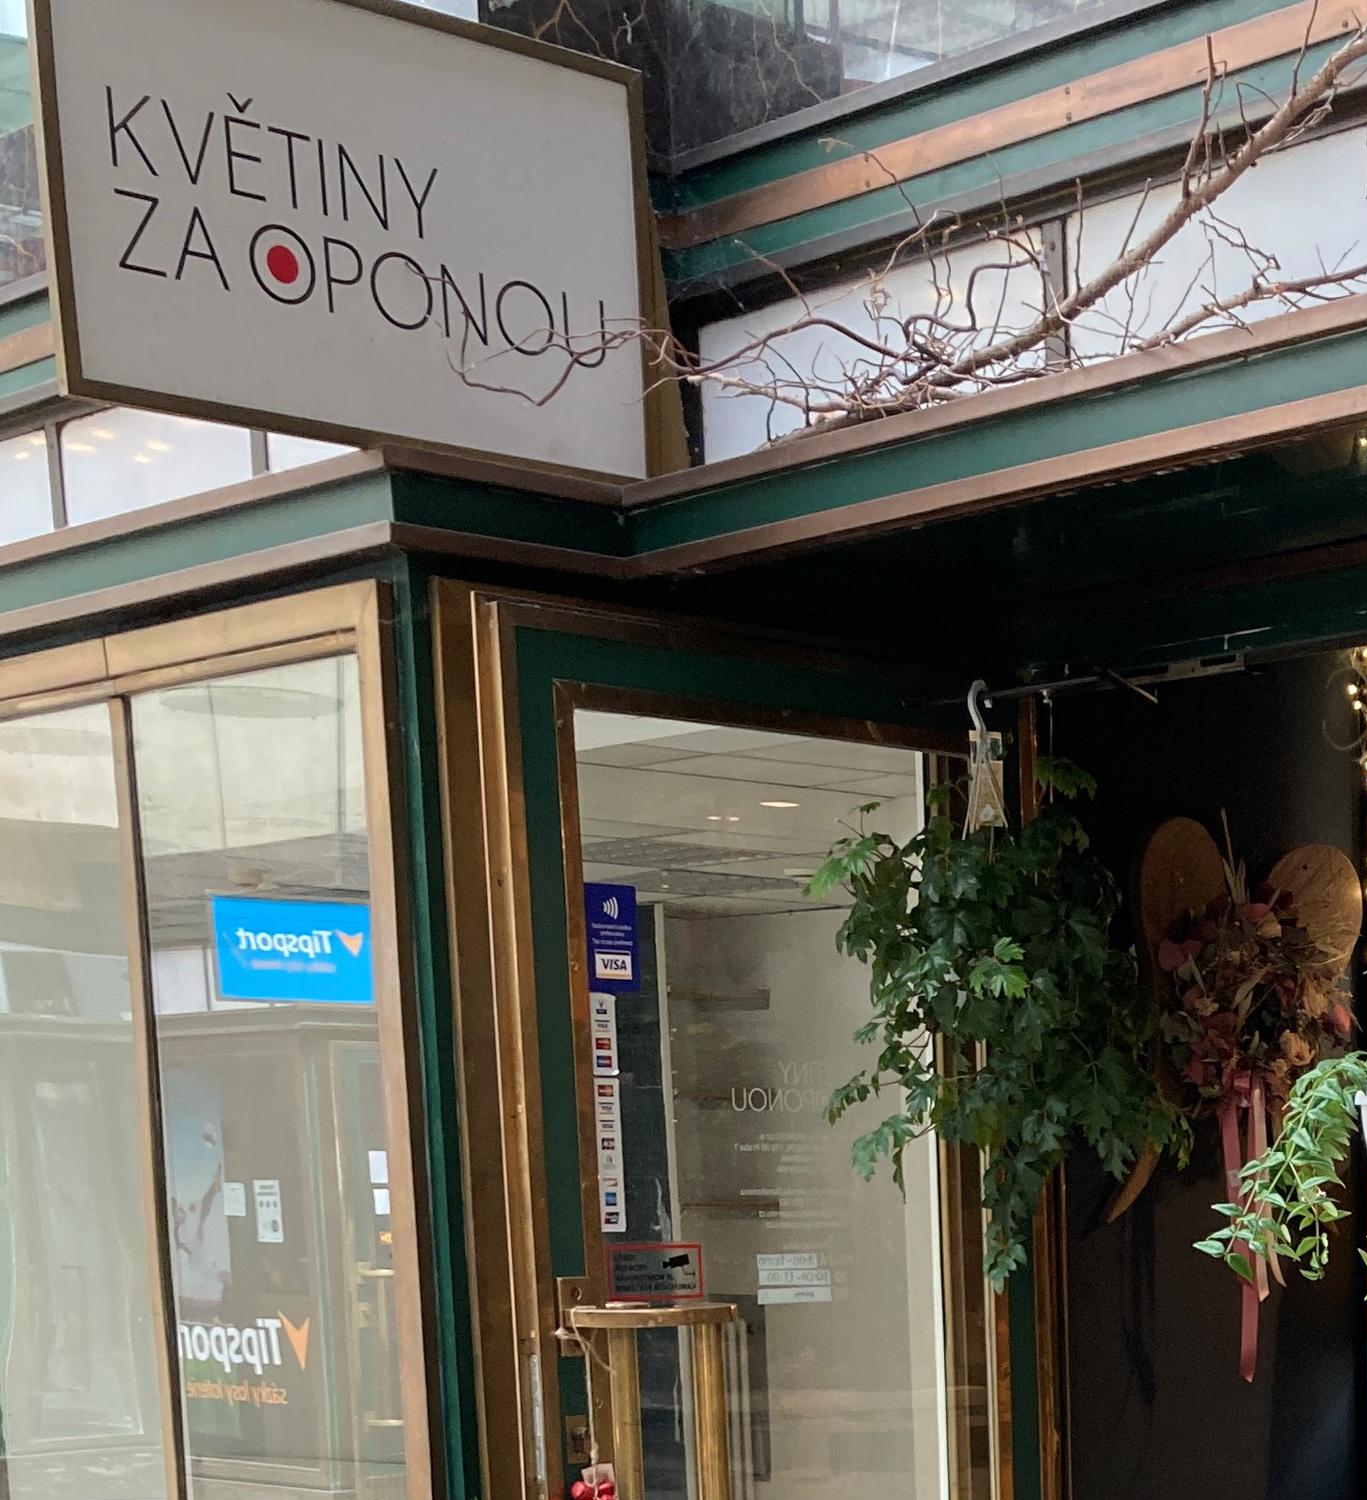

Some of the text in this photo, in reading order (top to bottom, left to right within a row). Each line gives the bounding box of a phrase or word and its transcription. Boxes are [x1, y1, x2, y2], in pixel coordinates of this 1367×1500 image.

[105, 85, 438, 239] KVĚTINY
[113, 187, 607, 369] ZA OPONOU
[602, 958, 627, 971] VISA
